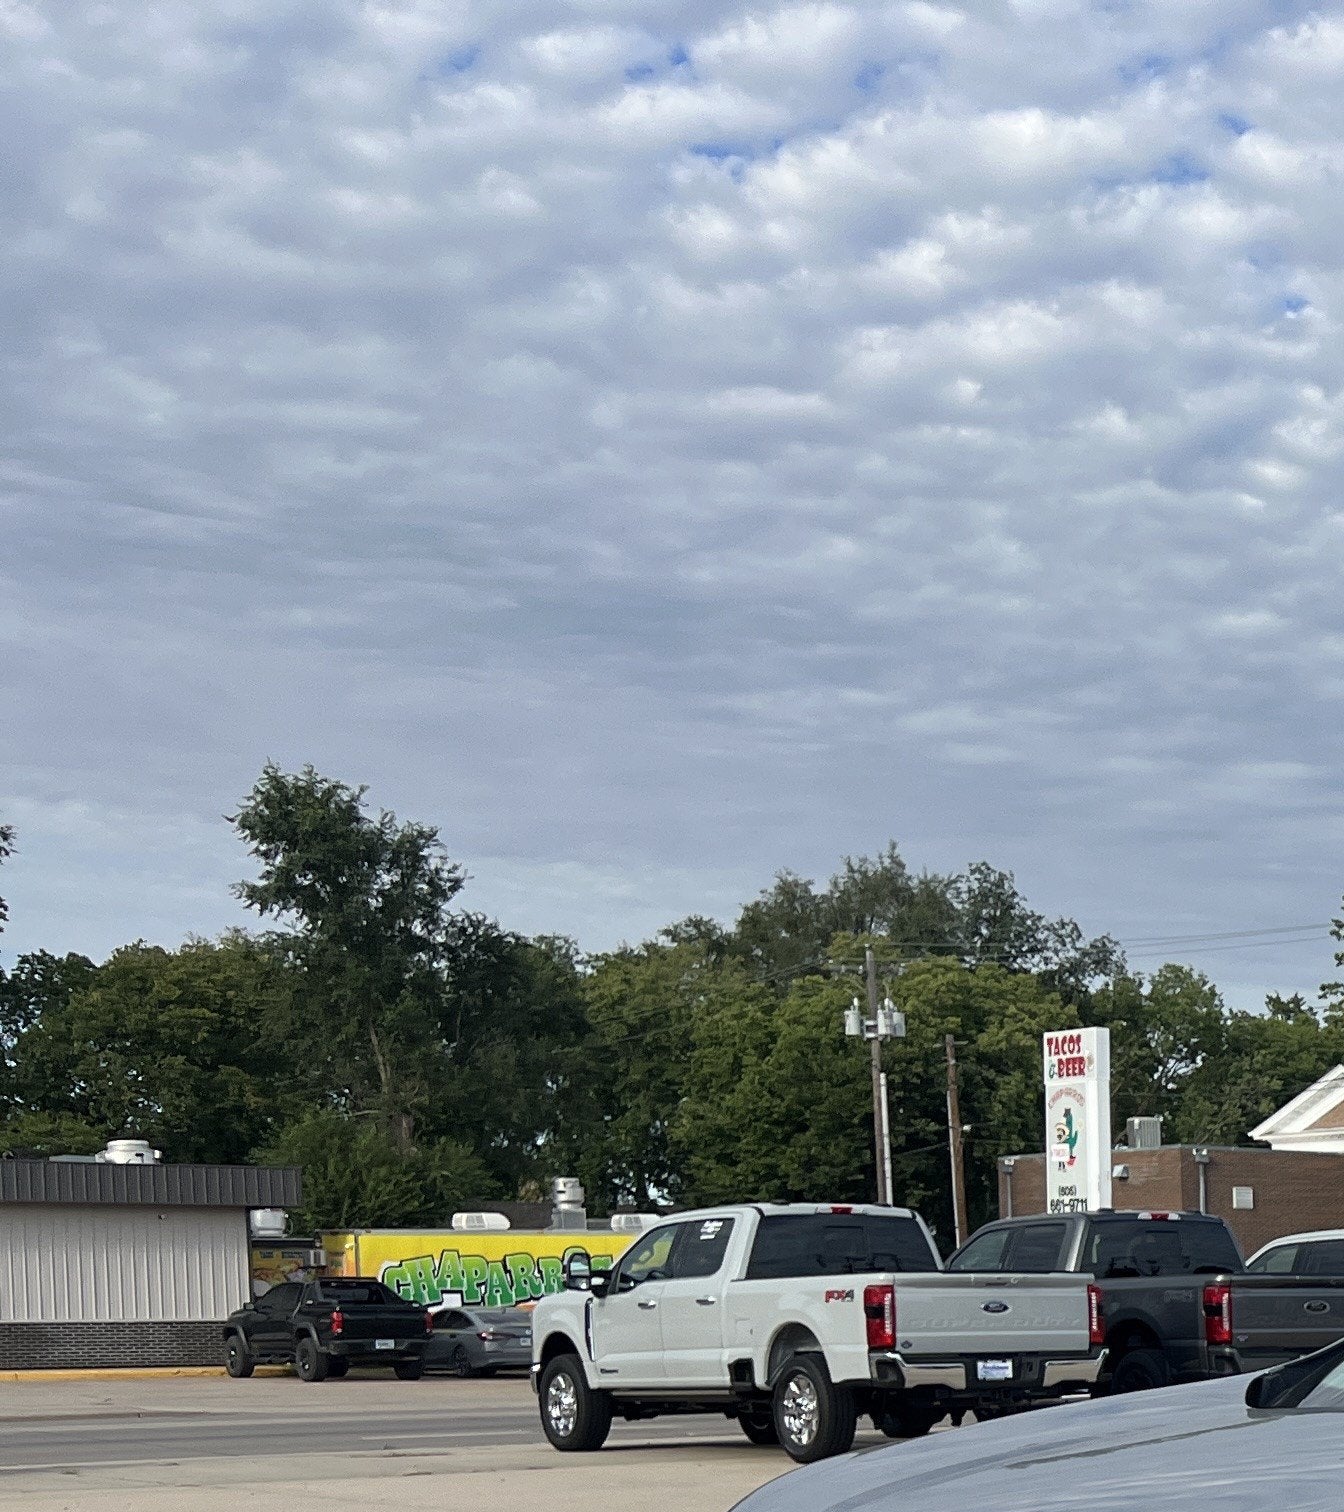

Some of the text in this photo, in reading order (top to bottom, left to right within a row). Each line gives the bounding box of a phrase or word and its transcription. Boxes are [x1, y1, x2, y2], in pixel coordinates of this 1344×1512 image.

[1046, 1033, 1082, 1057] TACOS
[1057, 1056, 1086, 1078] BEER
[825, 1289, 855, 1303] FX4
